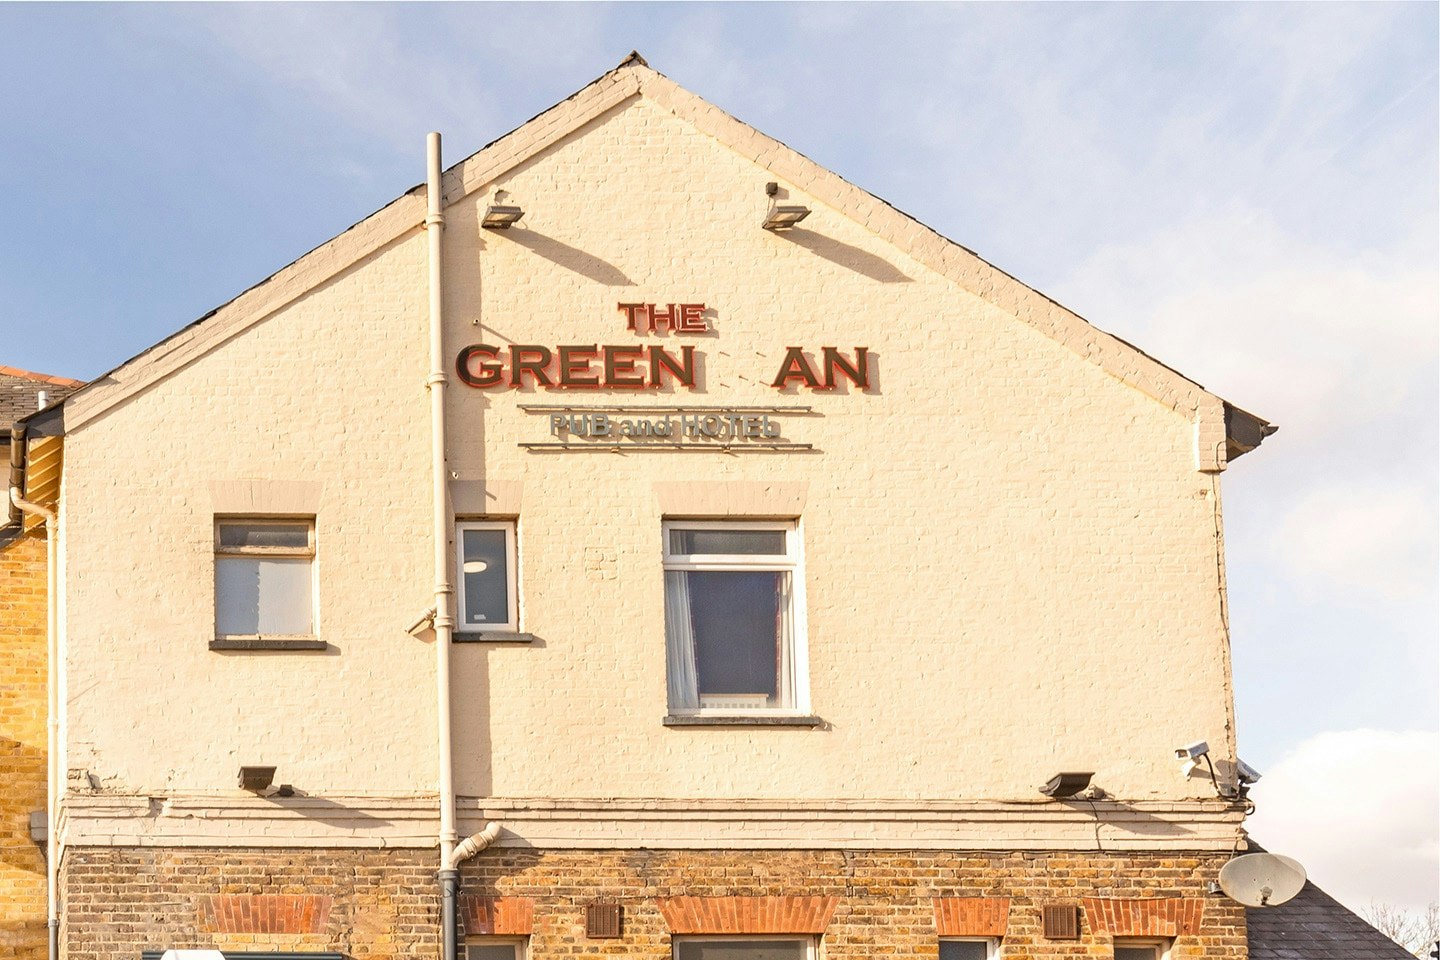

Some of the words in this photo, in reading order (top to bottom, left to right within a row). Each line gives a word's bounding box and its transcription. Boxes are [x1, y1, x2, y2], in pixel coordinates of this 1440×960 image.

[617, 302, 707, 332] THE
[455, 343, 696, 389] GREEN
[549, 413, 610, 436] PUB
[619, 413, 670, 436] and
[680, 413, 780, 437] HOTEL
